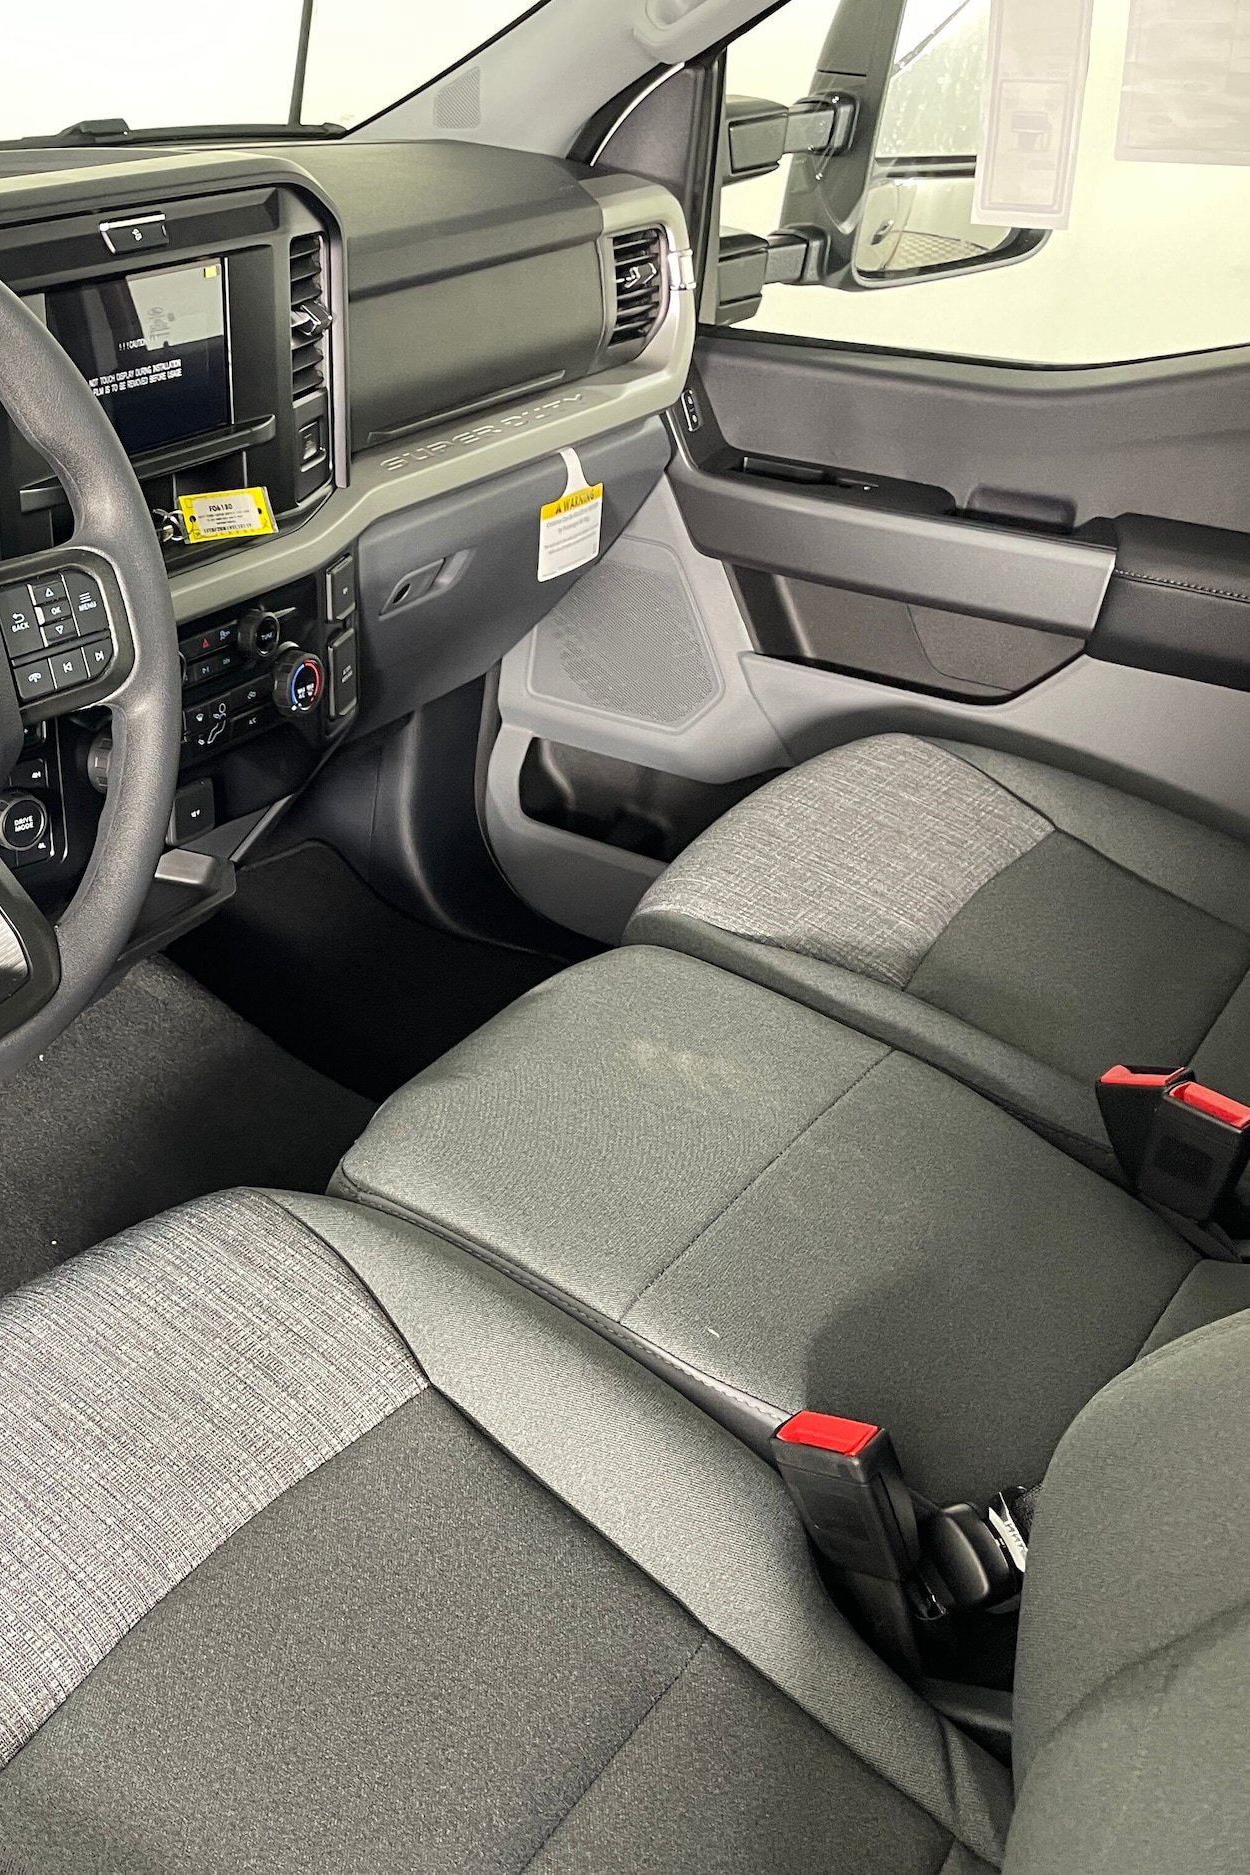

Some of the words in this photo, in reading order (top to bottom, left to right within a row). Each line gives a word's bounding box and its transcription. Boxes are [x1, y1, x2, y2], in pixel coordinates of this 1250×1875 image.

[100, 375, 115, 385] TOUCH
[116, 370, 134, 380] DISPLAY
[135, 366, 152, 377] DURING
[152, 359, 181, 372] INSTALLATION
[149, 372, 166, 384] BEFORE
[167, 368, 182, 379] USAGE
[51, 606, 62, 615] OK
[78, 601, 97, 612] MENU
[12, 622, 30, 632] BACK
[14, 815, 33, 825] DRIVE
[15, 822, 34, 832] MODE
